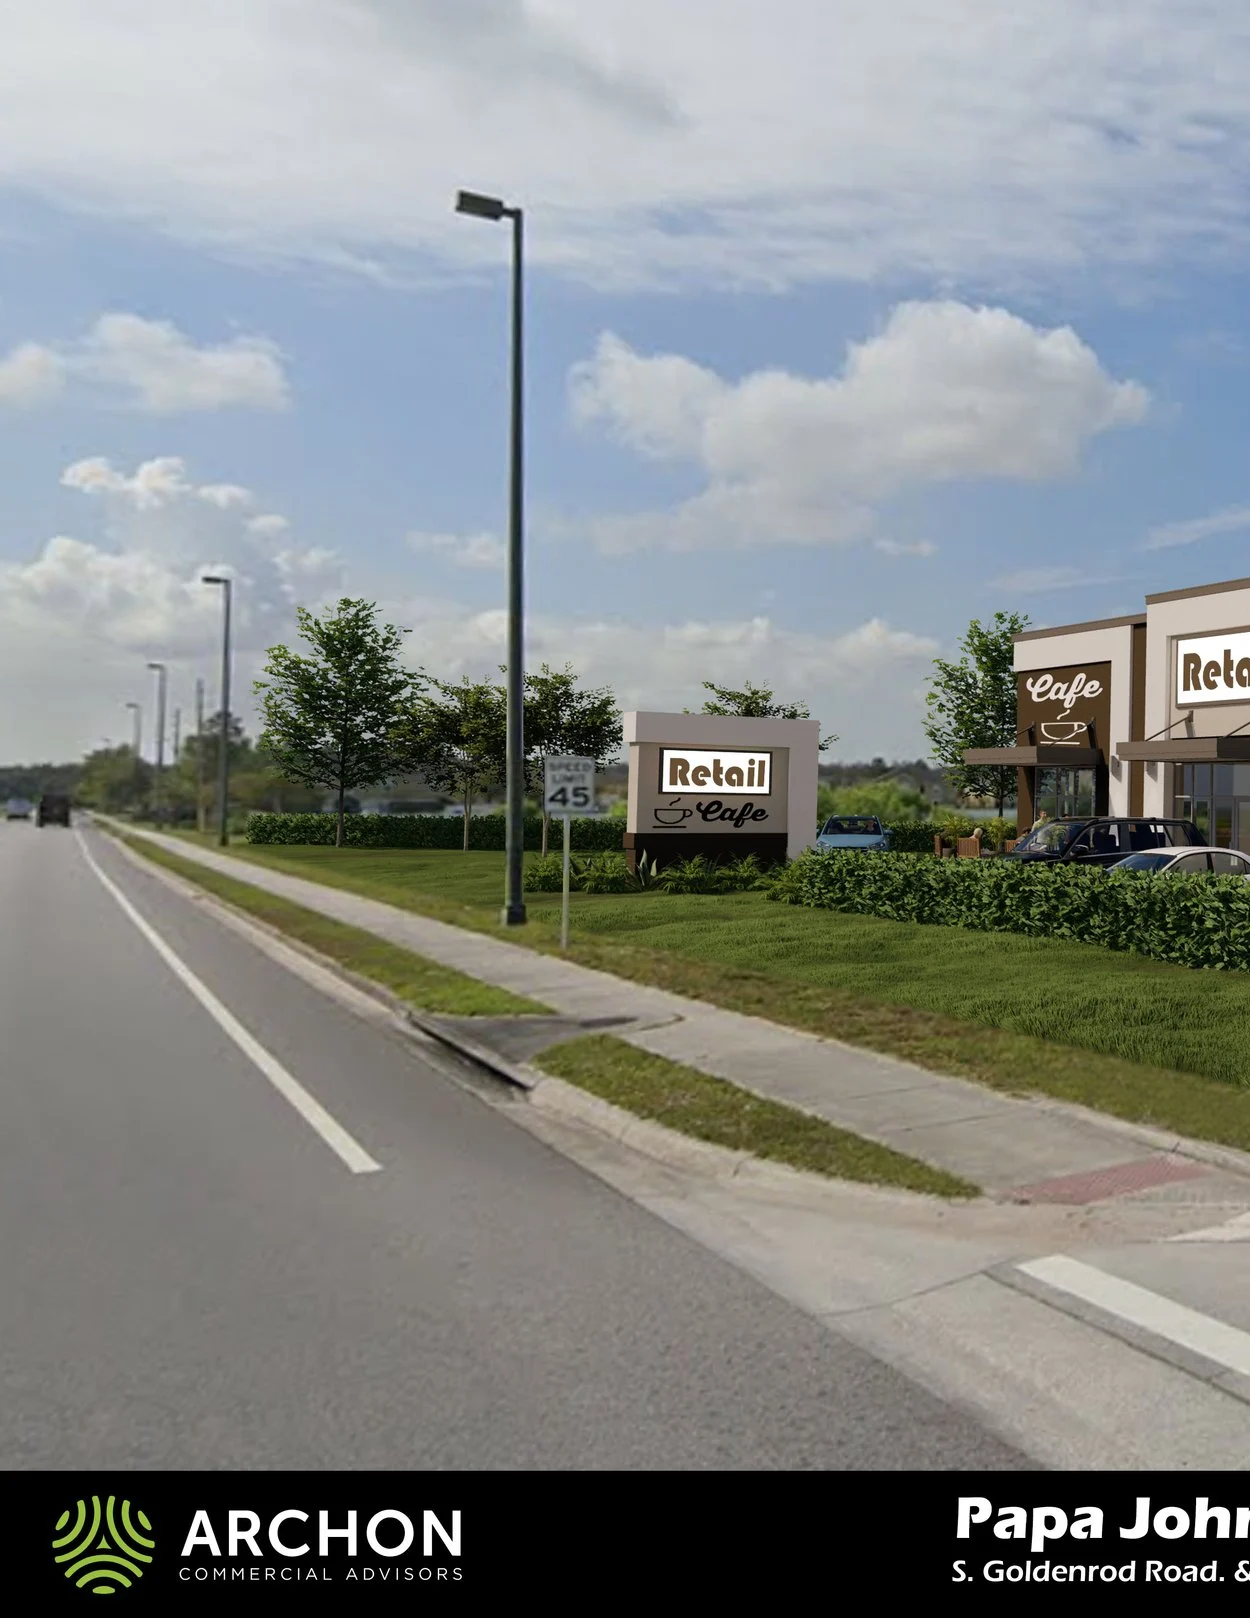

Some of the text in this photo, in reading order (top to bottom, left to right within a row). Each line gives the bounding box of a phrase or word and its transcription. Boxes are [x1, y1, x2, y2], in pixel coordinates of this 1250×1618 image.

[1026, 672, 1103, 708] Cafe
[549, 762, 592, 772] SPEED
[669, 757, 766, 787] Retail
[549, 786, 590, 807] 45
[696, 800, 769, 828] Cafe
